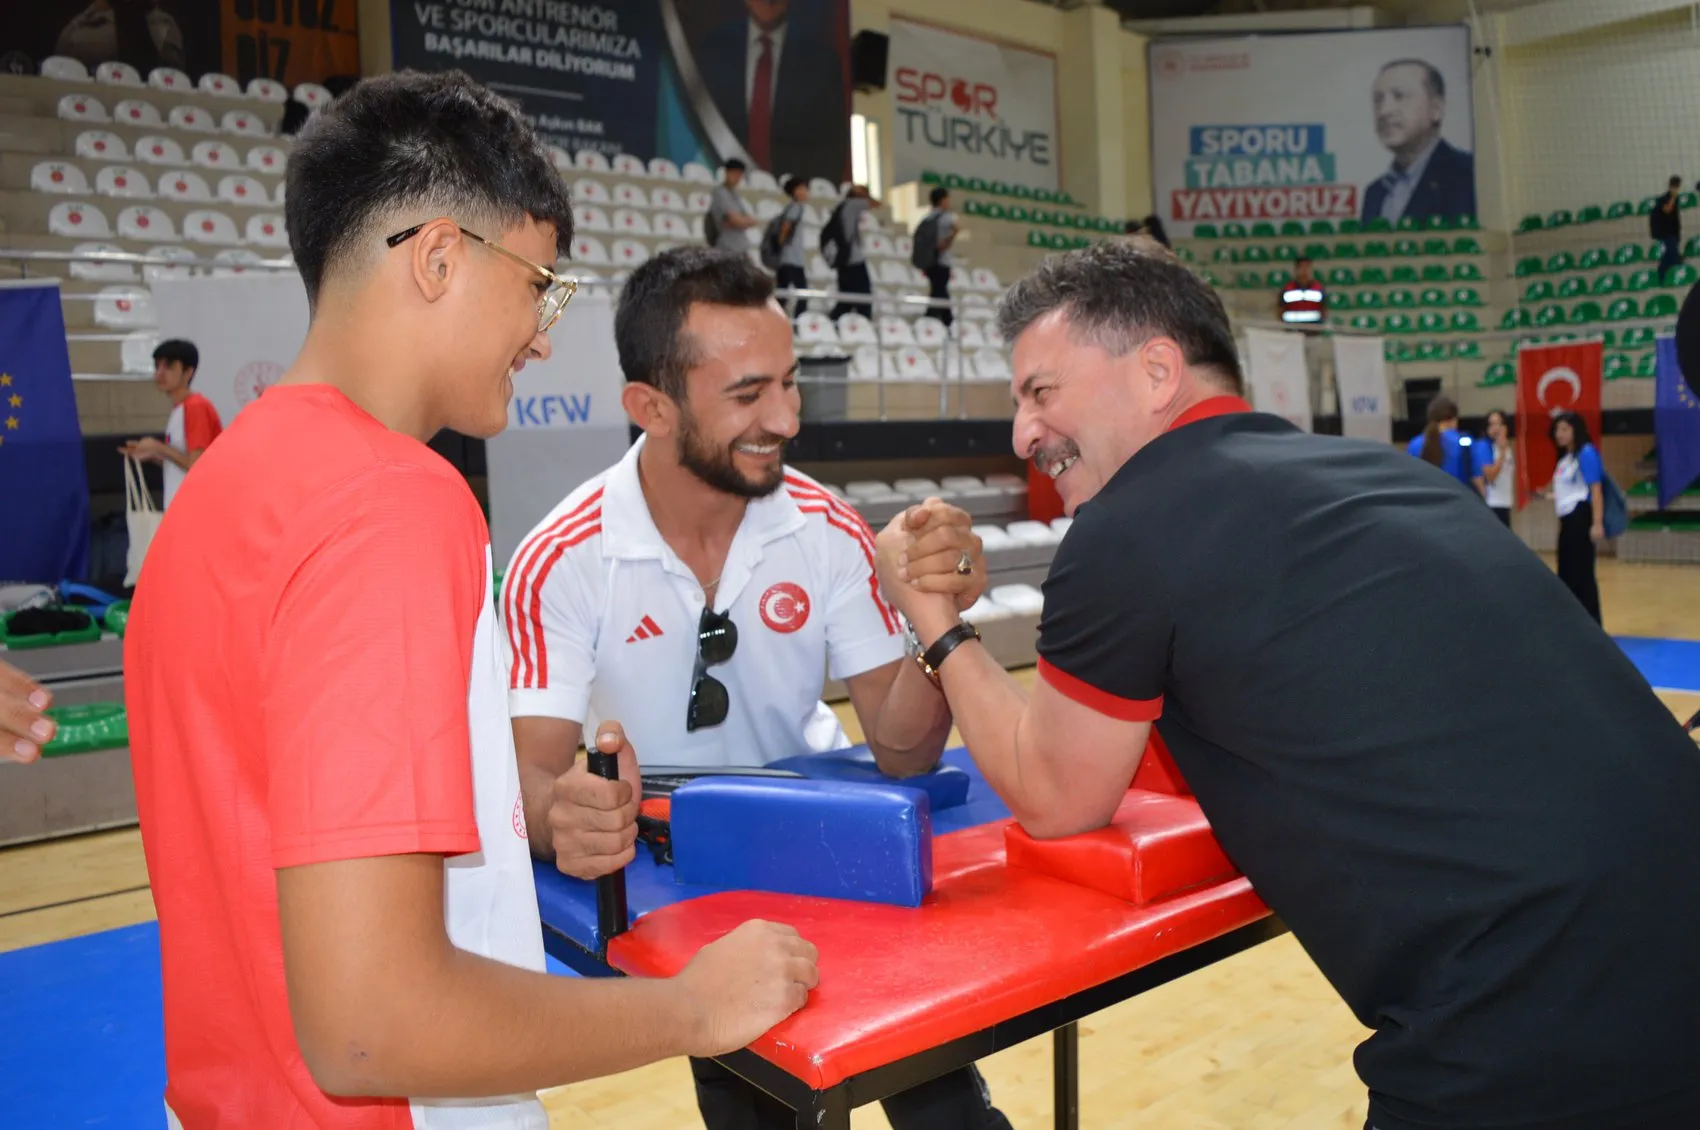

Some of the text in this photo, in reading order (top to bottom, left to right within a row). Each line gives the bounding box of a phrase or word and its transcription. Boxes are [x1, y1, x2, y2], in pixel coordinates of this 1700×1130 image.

[414, 1, 642, 60] VE SPORCULARIMIZA
[424, 32, 533, 66] BAŞARILAR
[896, 105, 1051, 166] TÜRKİYE
[1200, 127, 1309, 155] SPORU
[1193, 155, 1324, 187] TABANA
[1175, 187, 1354, 219] YAYIYORUZ
[516, 394, 591, 425] KFW
